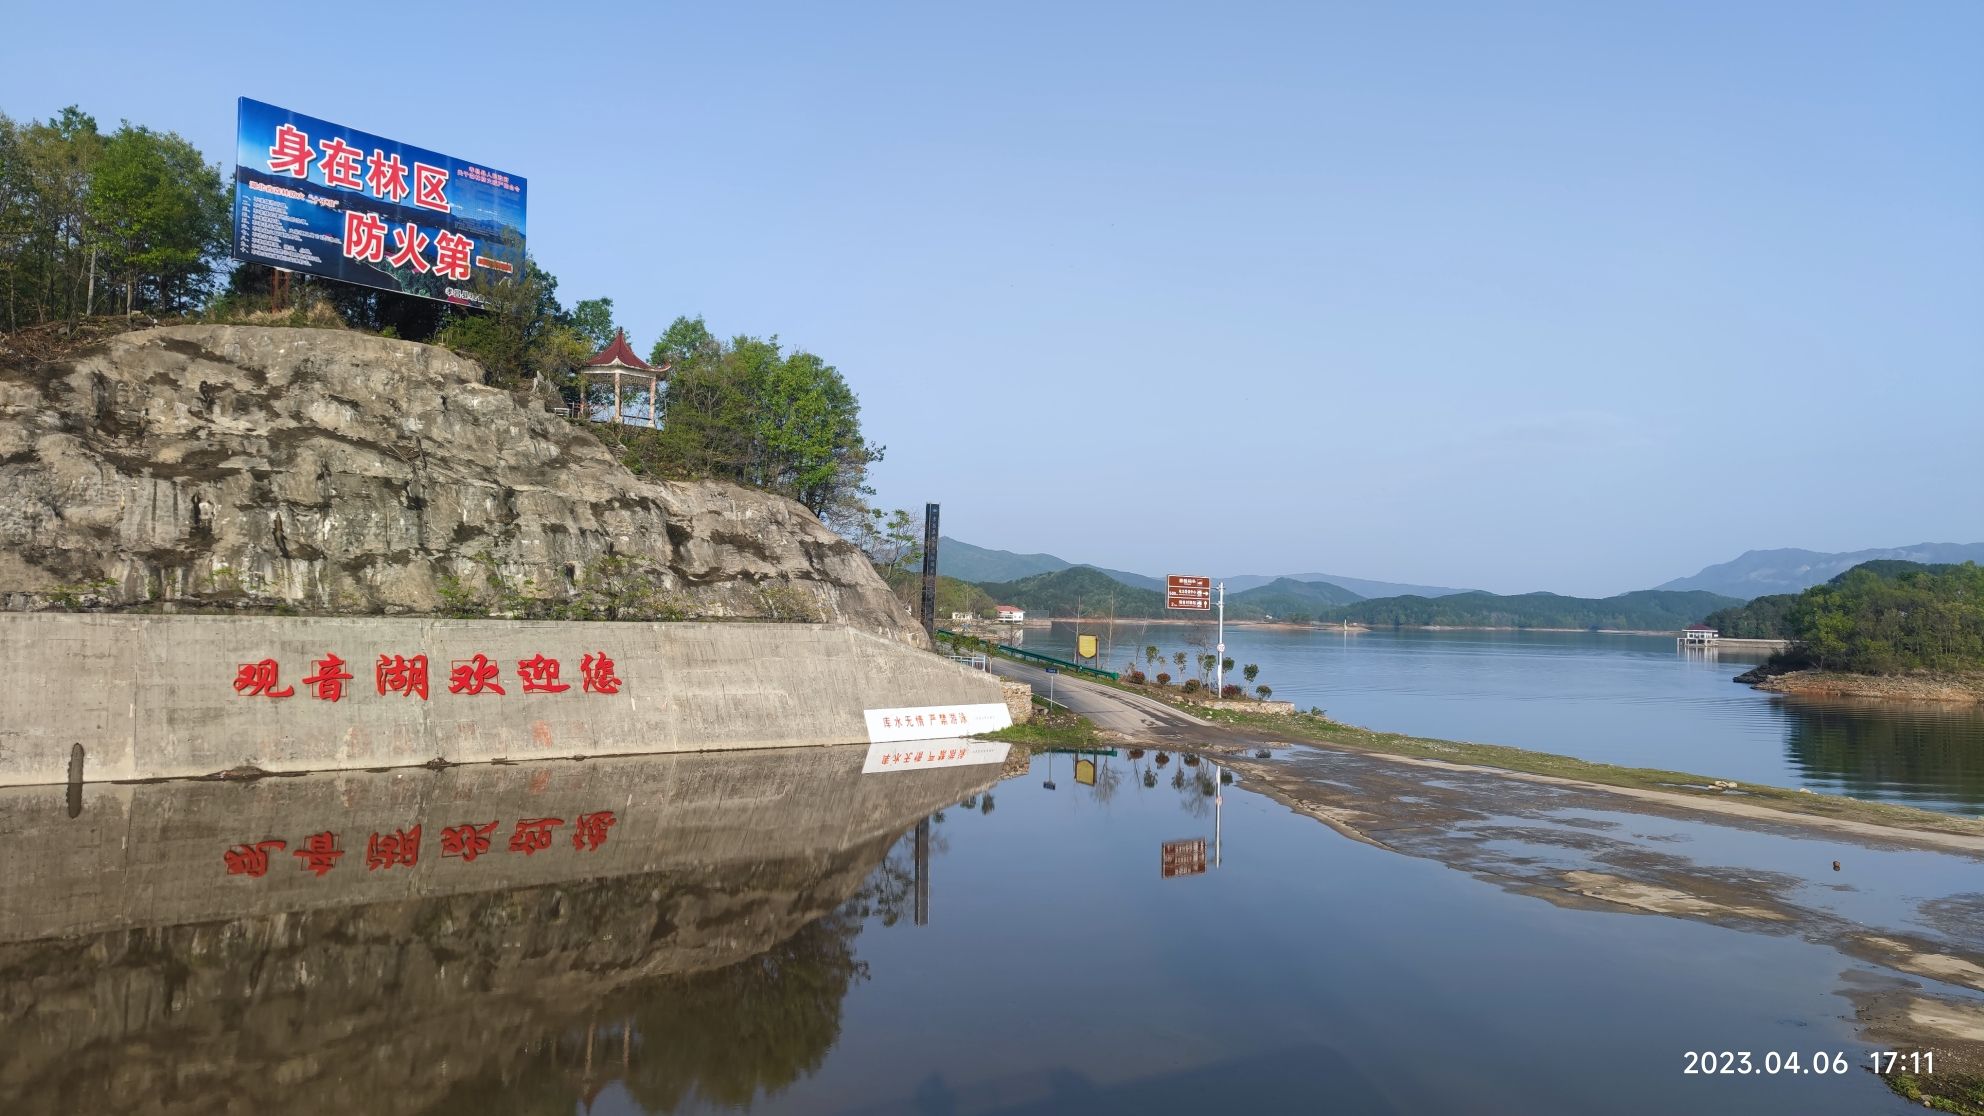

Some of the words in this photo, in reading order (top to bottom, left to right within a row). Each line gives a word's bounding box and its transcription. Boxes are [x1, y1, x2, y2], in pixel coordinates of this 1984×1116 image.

[267, 123, 451, 213] 身在林区
[343, 211, 514, 280] 防火第一
[234, 652, 622, 703] 观音湖欢迎您
